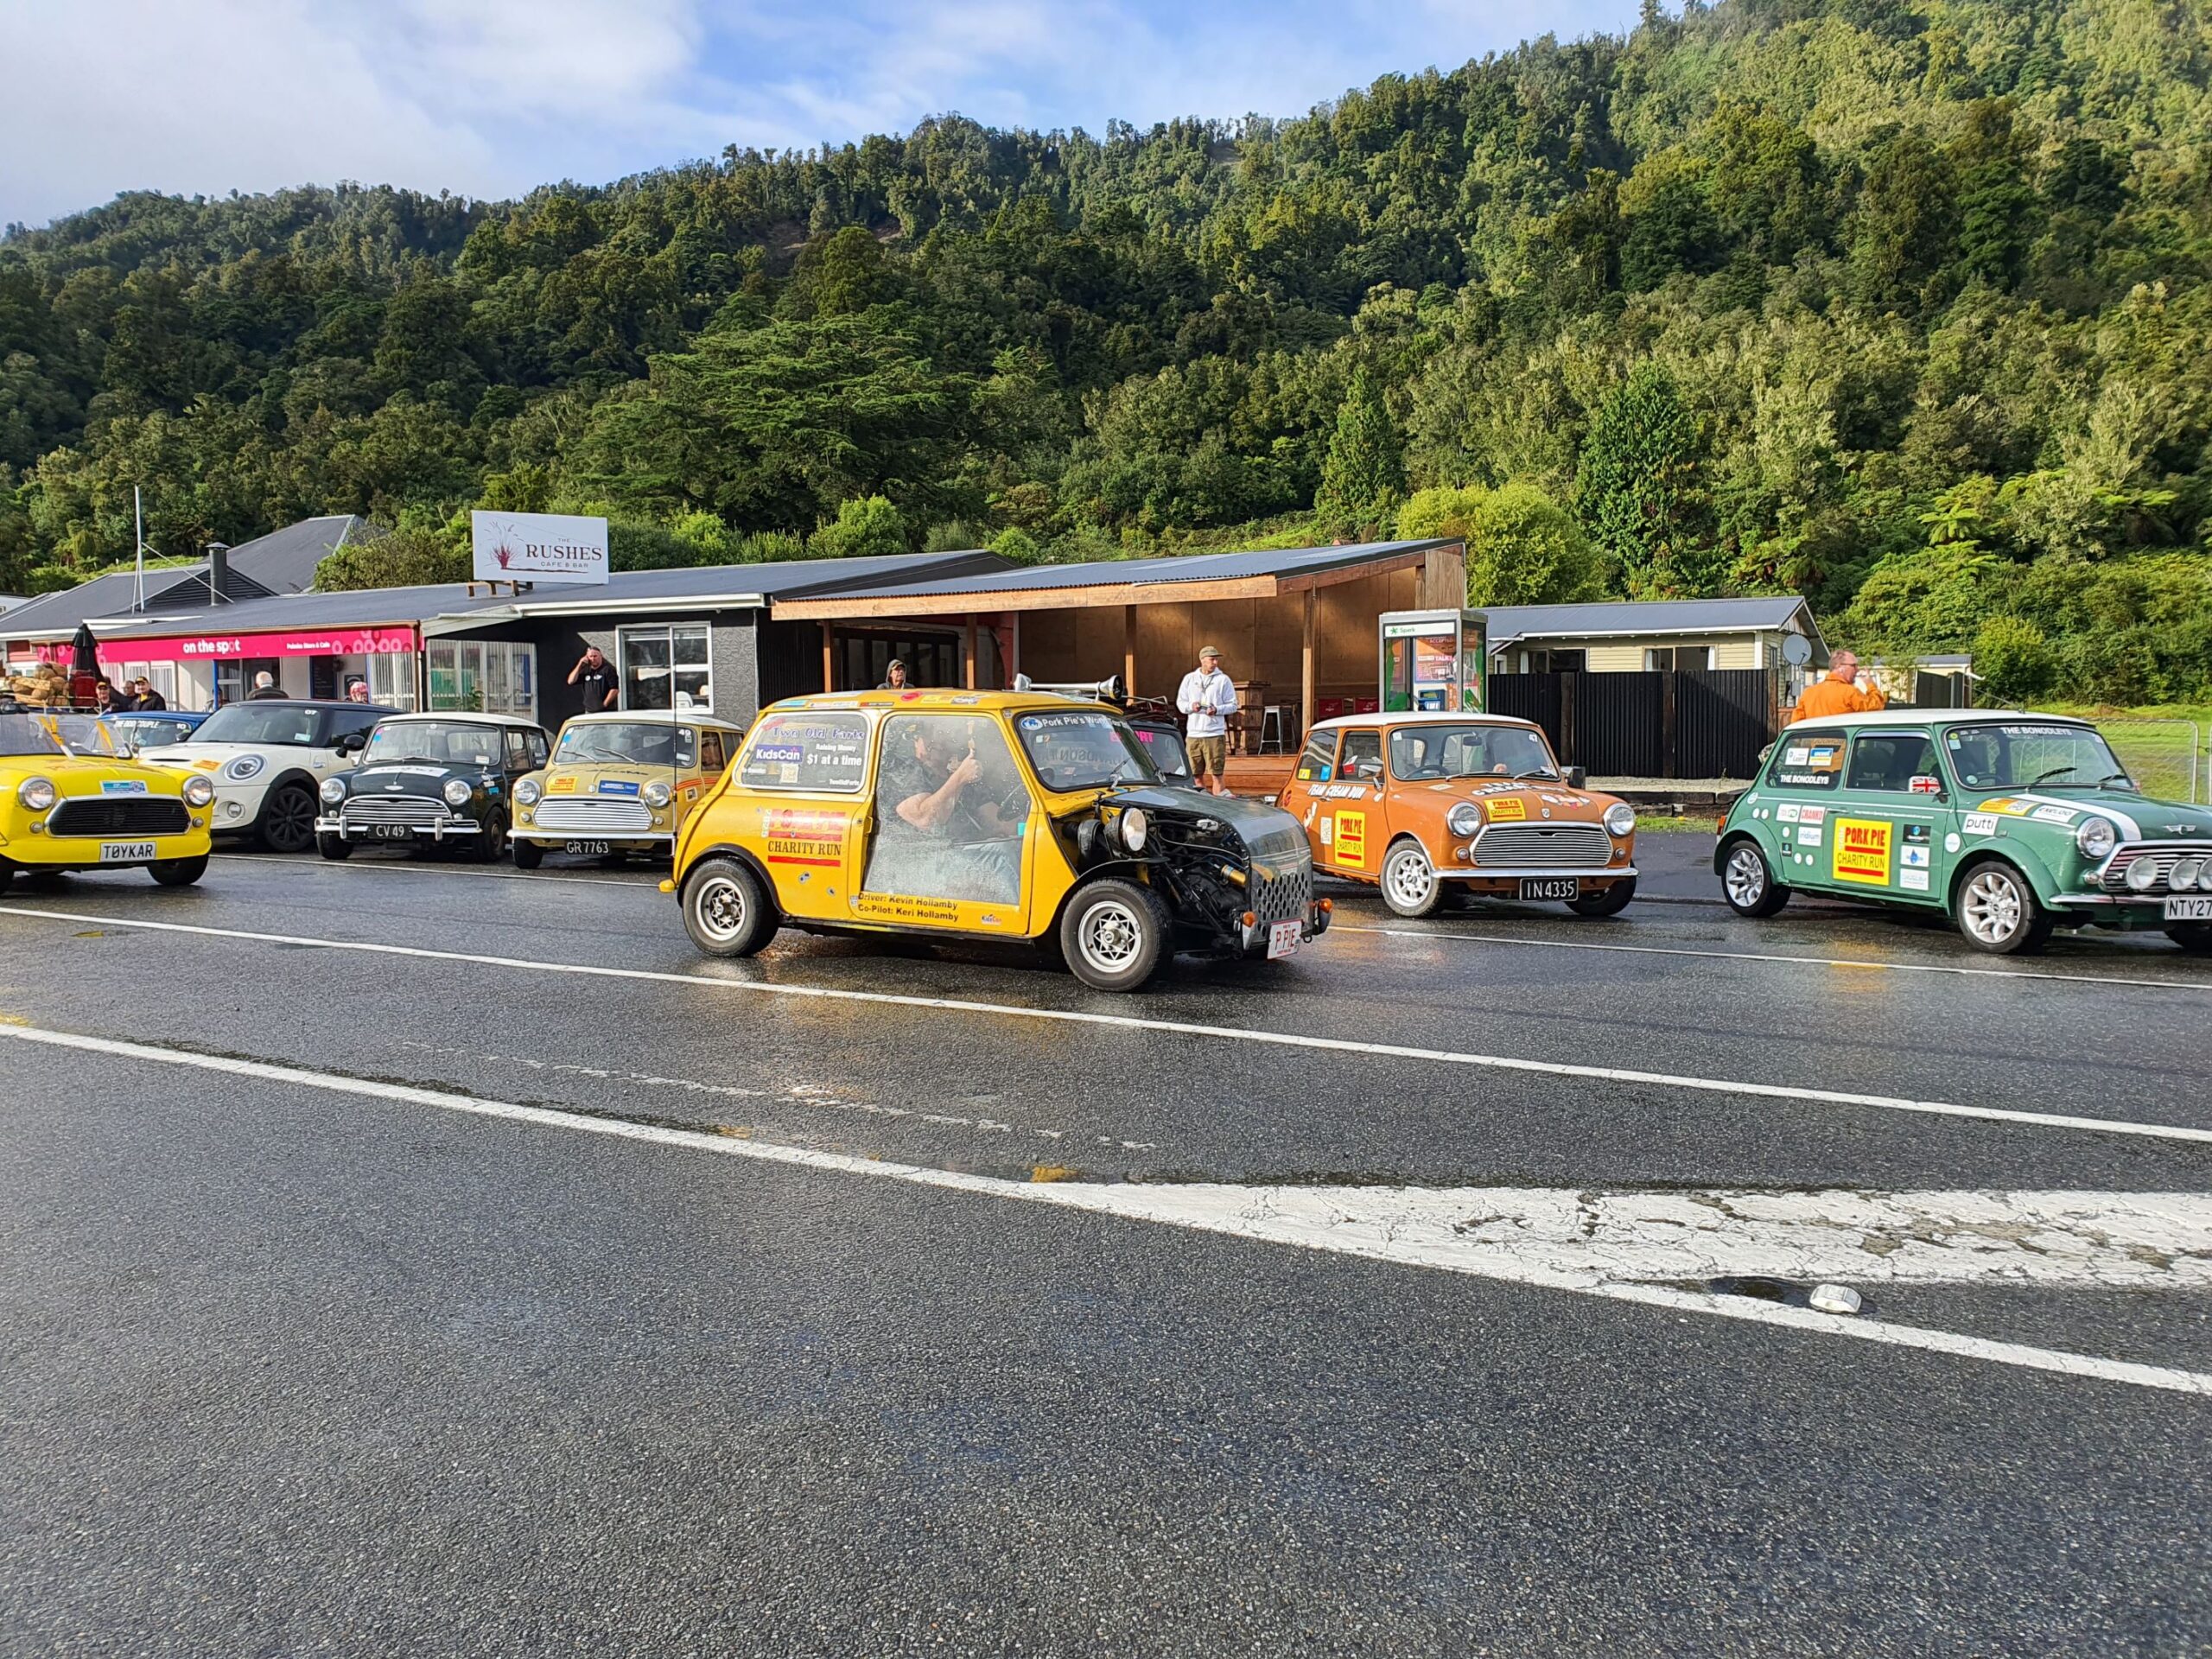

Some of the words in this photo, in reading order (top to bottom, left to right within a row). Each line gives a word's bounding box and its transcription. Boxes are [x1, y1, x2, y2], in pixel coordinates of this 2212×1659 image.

[525, 543, 602, 561] RUSHES
[183, 643, 197, 654] on
[198, 641, 215, 652] the
[216, 639, 240, 654] spot
[1042, 717, 1063, 727] Pork
[1064, 715, 1085, 725] Pie's
[773, 728, 800, 739] Two
[805, 727, 827, 739] Old
[832, 728, 864, 741] Farts
[756, 748, 800, 760] KidsCan
[816, 743, 836, 752] Raising
[807, 753, 818, 766] $1
[821, 754, 831, 765] at
[842, 755, 862, 766] time
[1780, 774, 1791, 783] THE
[376, 825, 390, 837] CV
[392, 825, 405, 836] 49
[1340, 817, 1353, 833] PORK
[1354, 818, 1363, 835] PIE
[1965, 817, 1995, 830] putti
[1845, 827, 1870, 846] PORK
[1871, 829, 1886, 847] PIE
[567, 842, 582, 854] GR
[584, 842, 609, 854] 7763
[768, 840, 815, 854] CHARITY
[817, 842, 842, 855] RUN
[1337, 840, 1352, 851] CHARITY
[1837, 853, 1868, 867] CHARITY
[1869, 856, 1885, 869] RUN
[1527, 882, 1543, 898] IN
[1545, 881, 1574, 898] 4335
[858, 893, 887, 902] Driver:
[889, 895, 913, 905] Kevin
[916, 895, 958, 911] Hollamby
[2169, 899, 2212, 917] NTY27
[858, 904, 893, 914] Co-Pilot:
[896, 907, 915, 917] Keri
[917, 907, 959, 922] Hollamby
[1274, 931, 1281, 950] P
[1283, 928, 1296, 949] PIE
